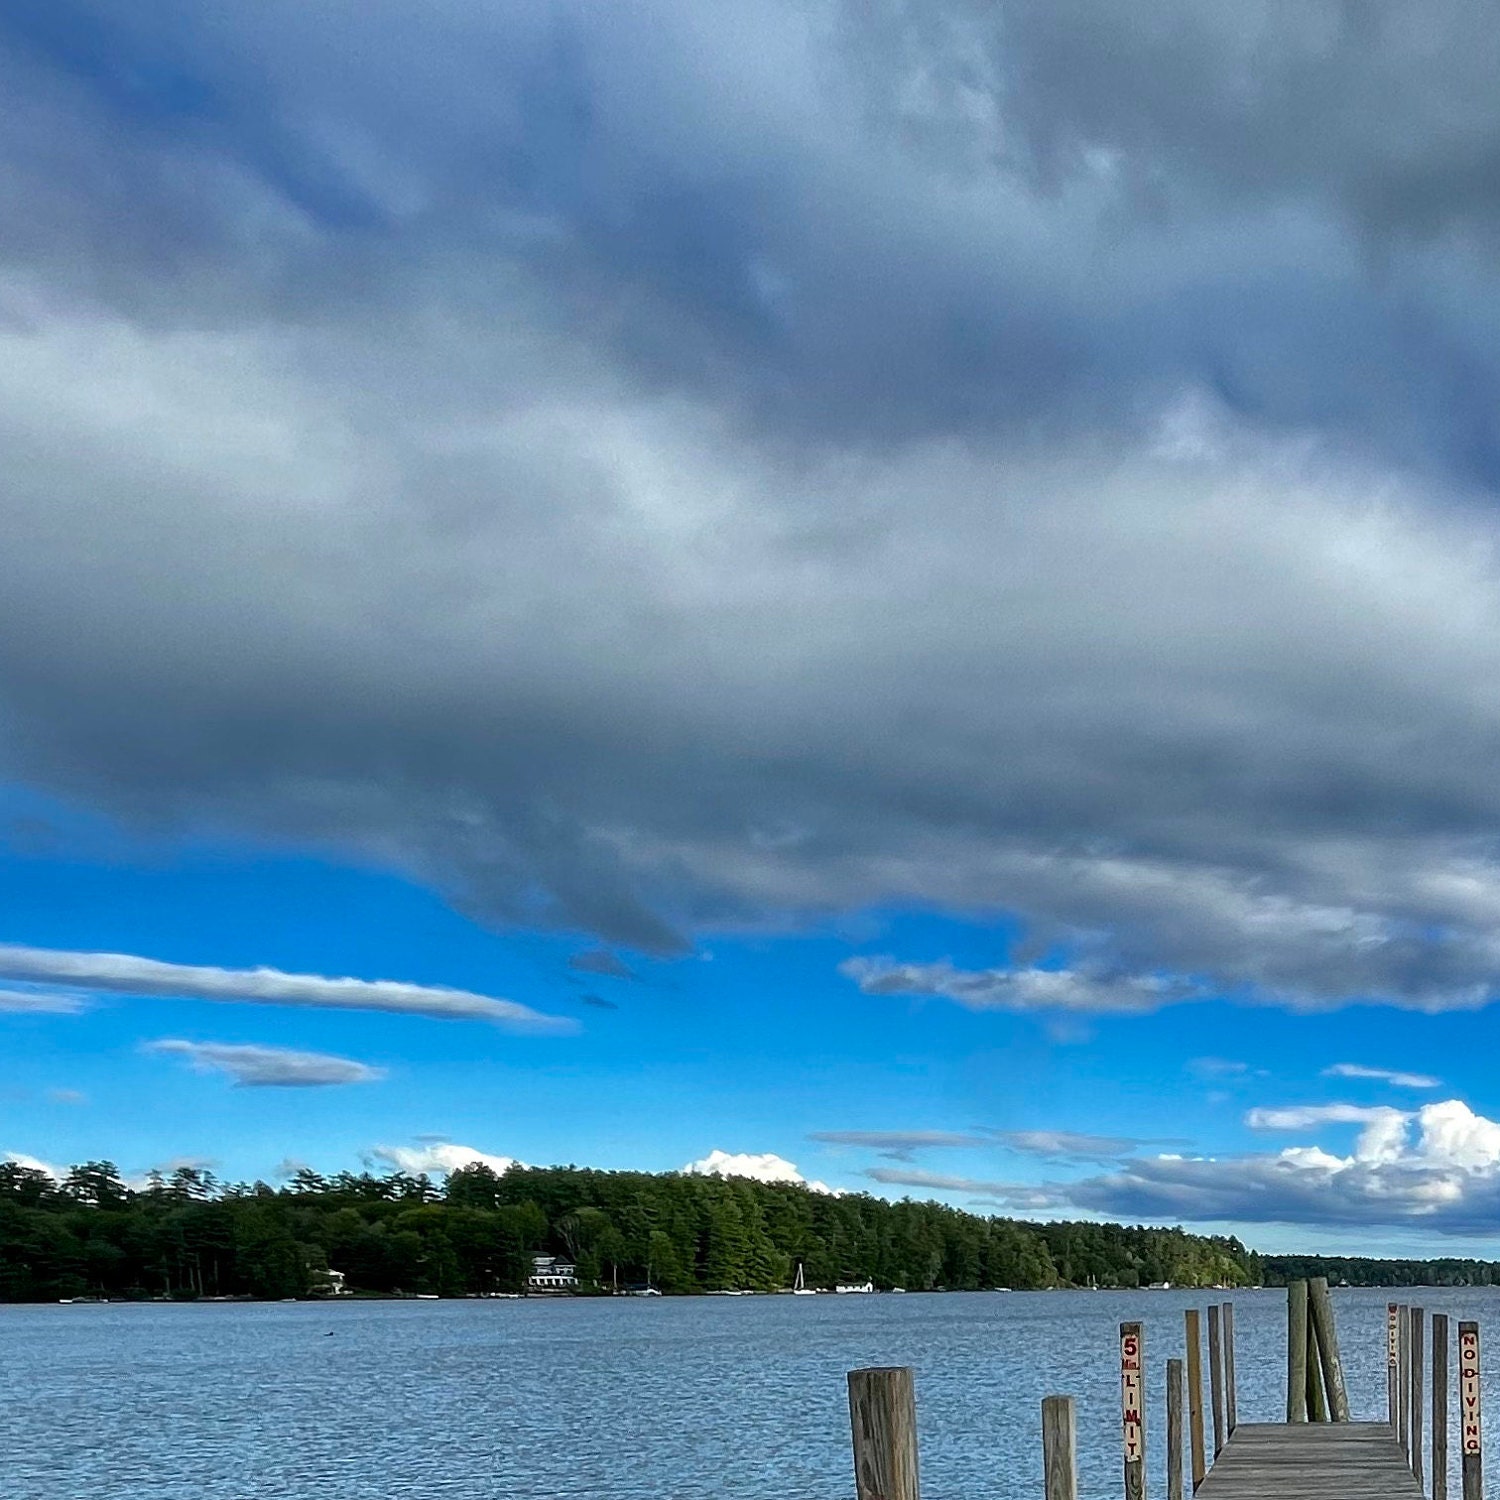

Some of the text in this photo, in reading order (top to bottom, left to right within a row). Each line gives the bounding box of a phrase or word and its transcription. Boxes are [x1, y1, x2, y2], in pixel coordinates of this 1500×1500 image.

[1124, 1338, 1137, 1356] 5
[1125, 1374, 1139, 1457] LIMIT
[1463, 1336, 1479, 1450] NO DIVING
